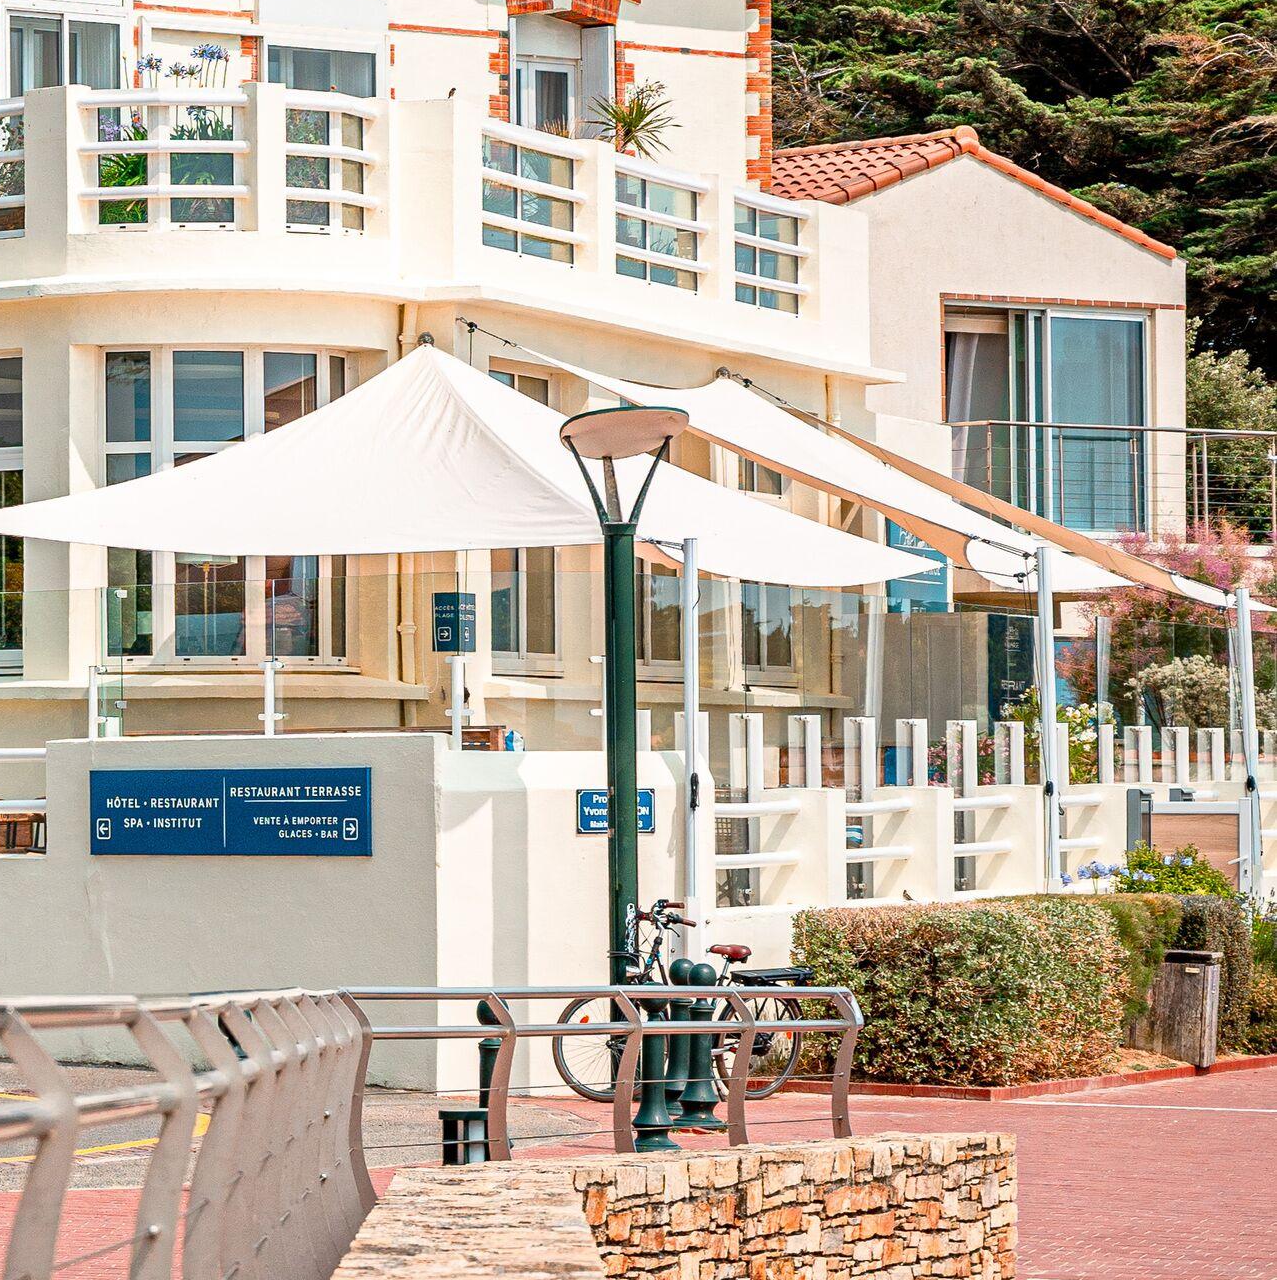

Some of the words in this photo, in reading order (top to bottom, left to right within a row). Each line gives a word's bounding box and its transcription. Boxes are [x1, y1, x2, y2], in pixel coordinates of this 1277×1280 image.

[230, 786, 301, 798] RESTAURANT
[304, 785, 362, 797] TERRASSE
[106, 796, 141, 809] HÔTEL
[150, 797, 220, 809] RESTAURANT
[123, 817, 144, 829] SPA
[153, 817, 202, 829] INSTITUT
[253, 816, 281, 826] VENTE
[283, 814, 290, 825] À
[291, 816, 338, 826] EMPORTER
[278, 829, 313, 839] GLACES
[320, 830, 339, 839] BAR
